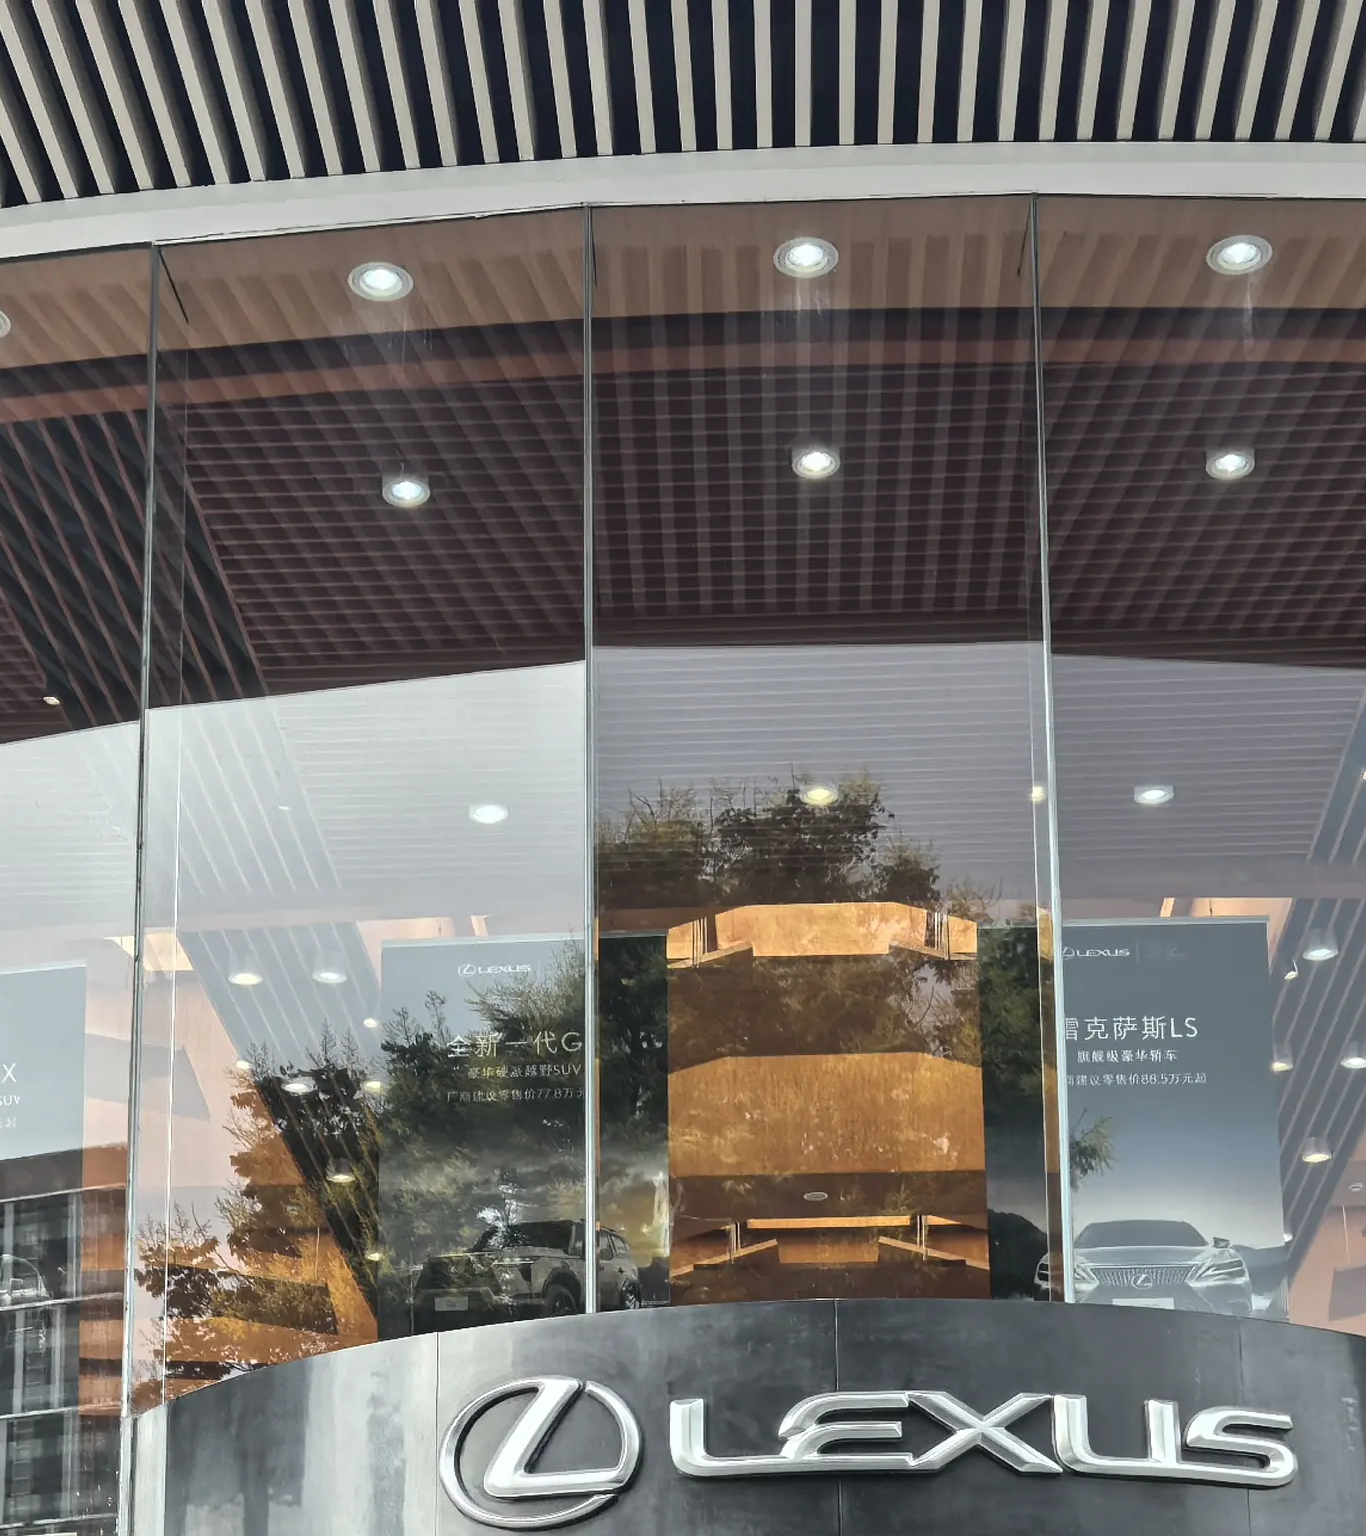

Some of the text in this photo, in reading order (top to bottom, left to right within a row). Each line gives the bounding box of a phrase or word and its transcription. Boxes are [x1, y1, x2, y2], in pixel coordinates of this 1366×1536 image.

[1077, 948, 1131, 958] LEXUS
[478, 964, 533, 975] LEXUS
[669, 1389, 1299, 1489] LEXUS
